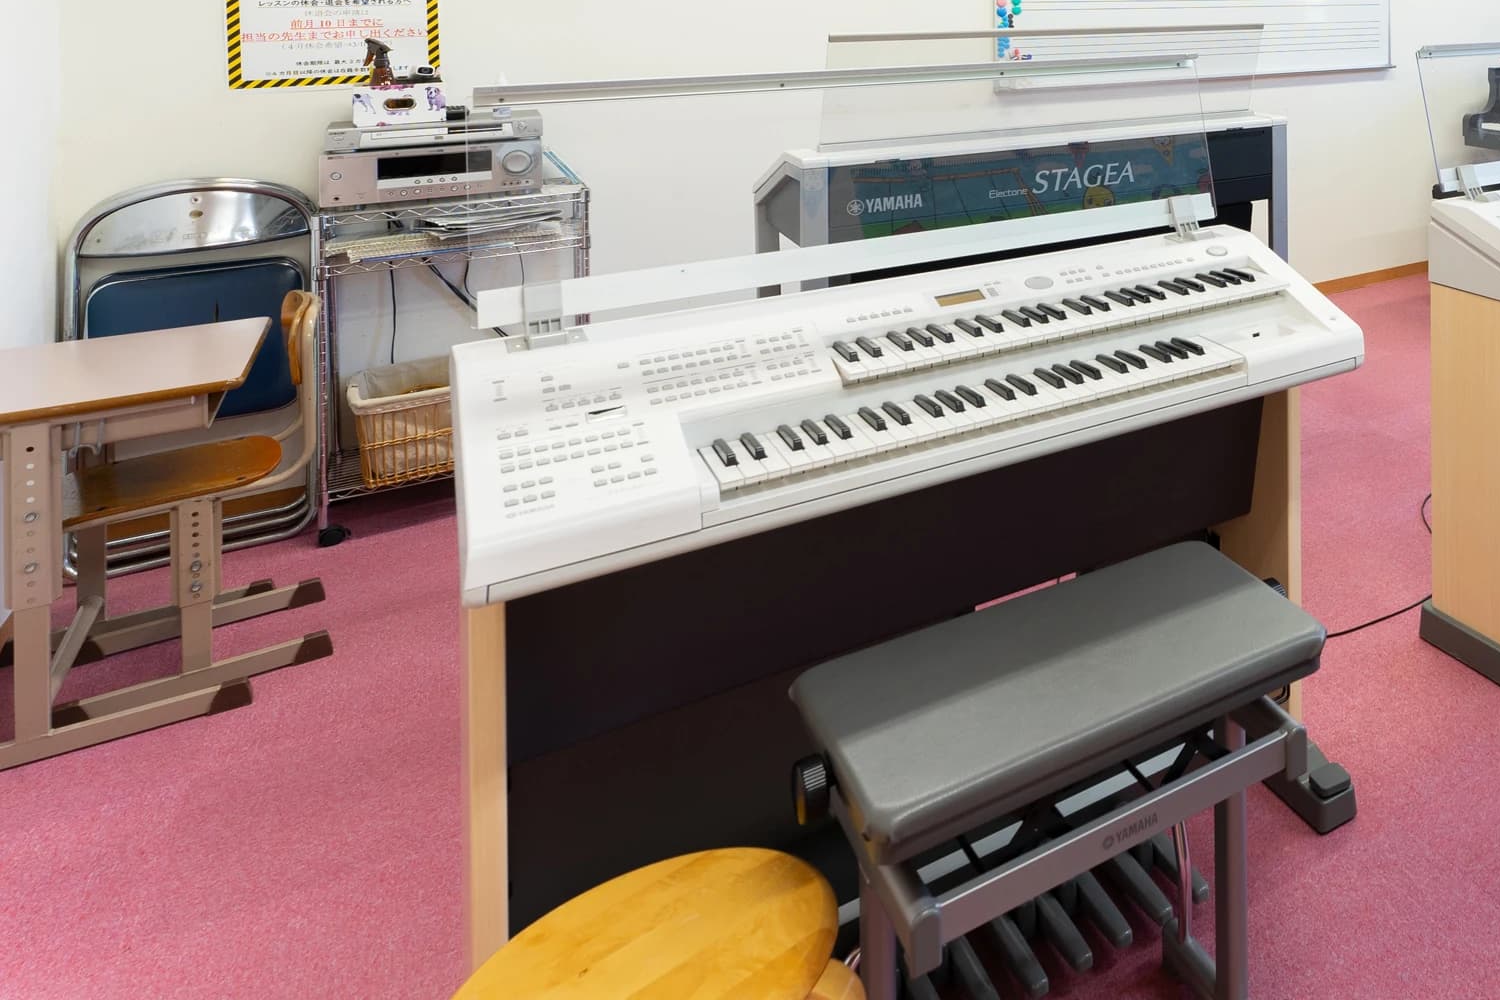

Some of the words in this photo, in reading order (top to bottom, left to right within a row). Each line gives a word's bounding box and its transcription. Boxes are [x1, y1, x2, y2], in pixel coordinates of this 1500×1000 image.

[988, 187, 1028, 199] Electone
[1032, 160, 1135, 194] STAGEA
[866, 193, 923, 214] YAMAHA
[1115, 812, 1158, 844] YAMAHA
